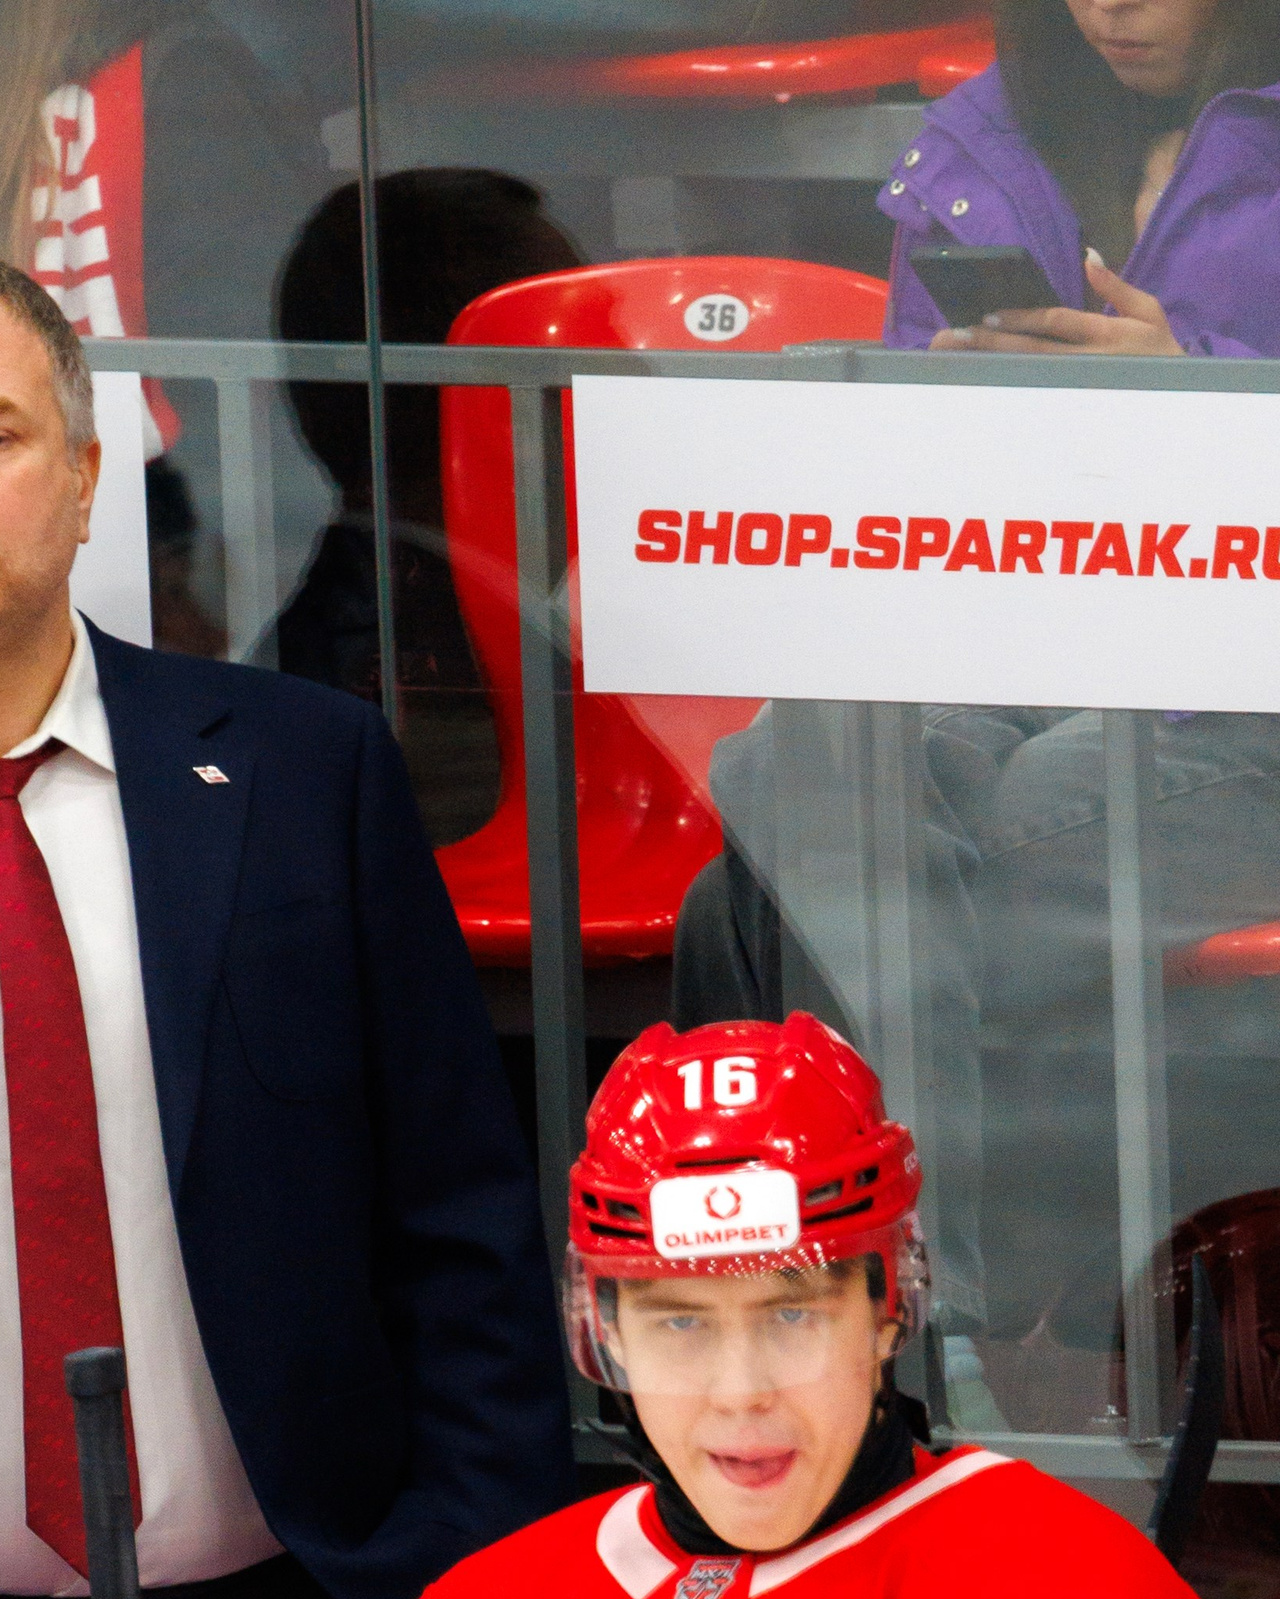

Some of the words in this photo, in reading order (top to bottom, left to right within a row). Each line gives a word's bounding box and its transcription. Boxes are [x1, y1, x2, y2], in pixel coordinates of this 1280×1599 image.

[698, 303, 736, 332] 36
[677, 1055, 757, 1111] 16
[664, 1224, 788, 1249] OLIMPBET
